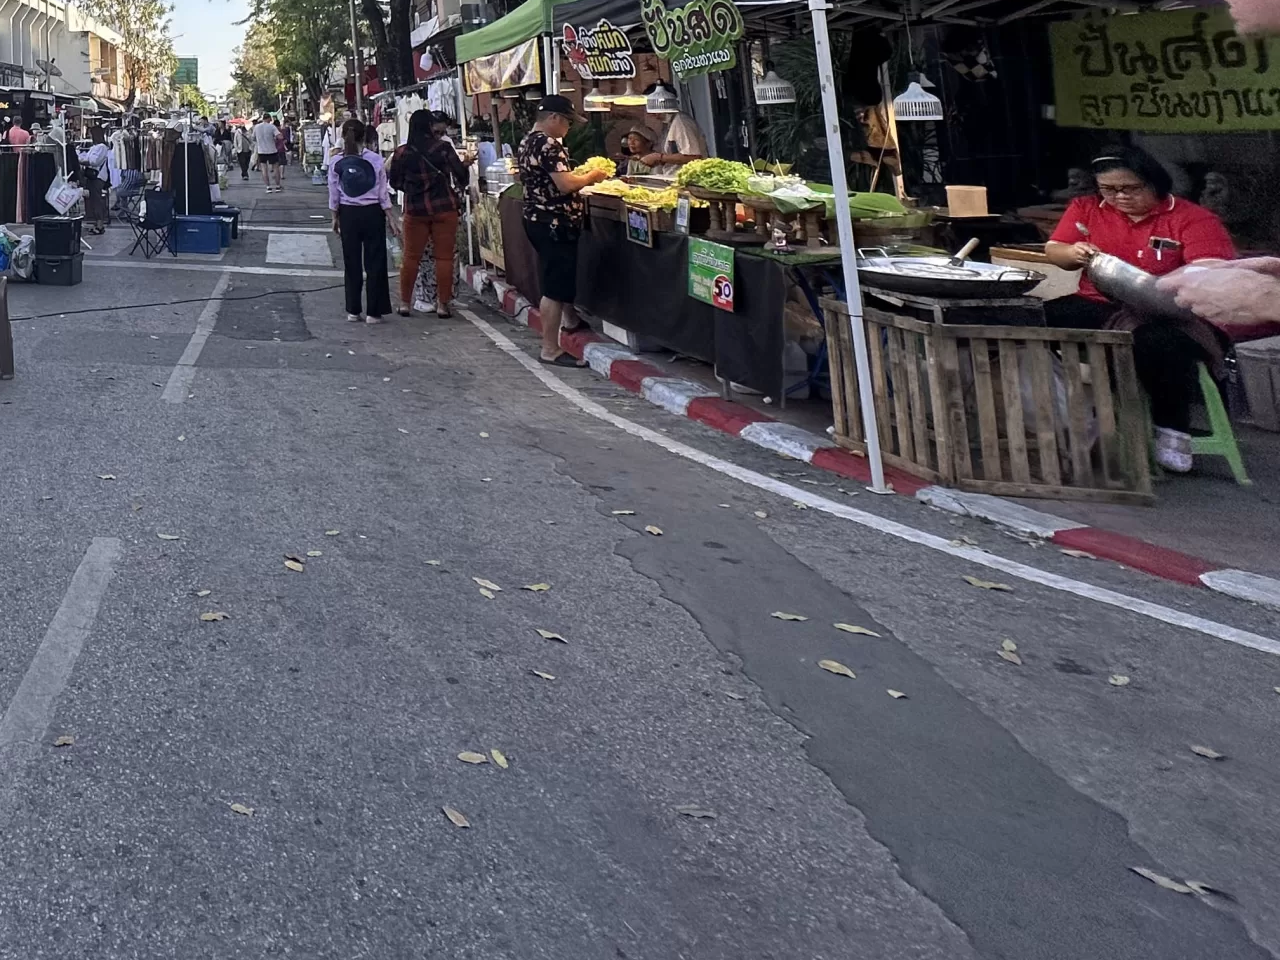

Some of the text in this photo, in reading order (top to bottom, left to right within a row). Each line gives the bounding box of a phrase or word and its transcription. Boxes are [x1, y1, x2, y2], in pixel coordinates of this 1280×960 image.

[587, 48, 631, 72] หมึกย่าง
[1078, 73, 1280, 126] ลูกชิ้นท่าแ
[714, 279, 732, 299] 50
